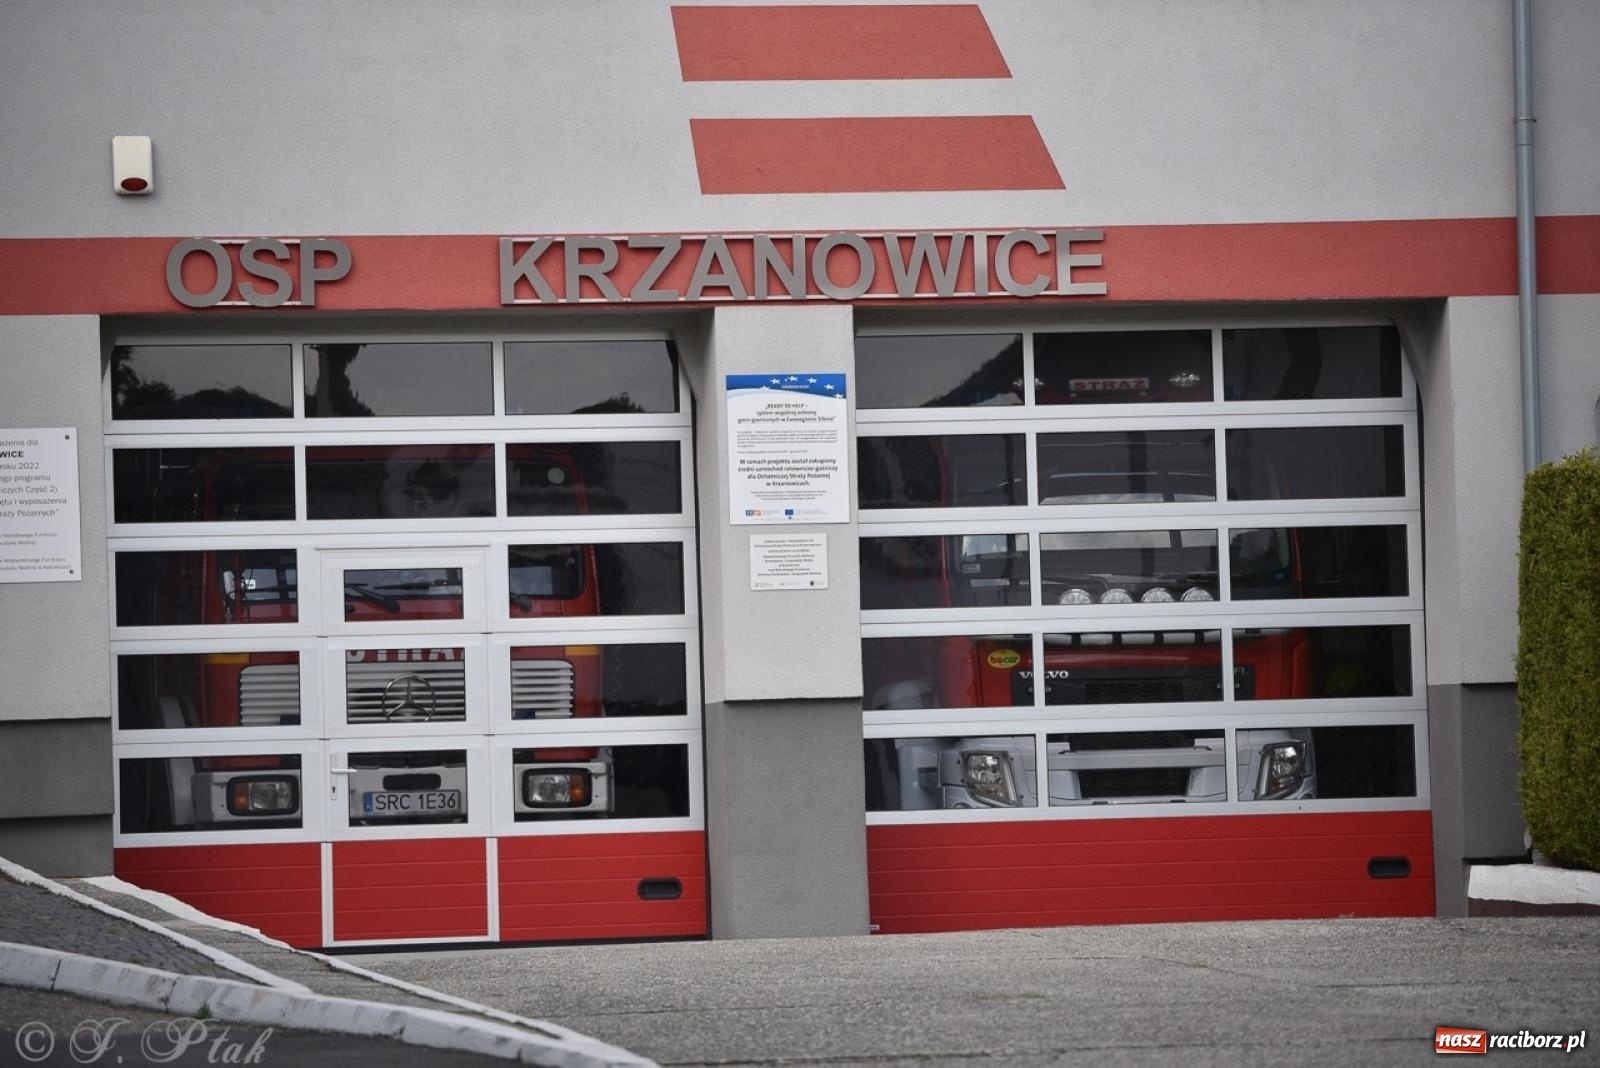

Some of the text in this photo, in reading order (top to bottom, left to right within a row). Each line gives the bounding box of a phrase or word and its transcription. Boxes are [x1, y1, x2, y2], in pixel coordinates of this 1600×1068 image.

[165, 228, 1108, 308] OSP KRZANOWICE
[1073, 378, 1146, 391] STRAŻ
[18, 462, 40, 470] 2022
[14, 474, 51, 483] programu
[25, 485, 48, 494] Część
[19, 498, 67, 506] wyposażenia
[375, 794, 411, 811] SRC
[418, 793, 457, 810] 1E36
